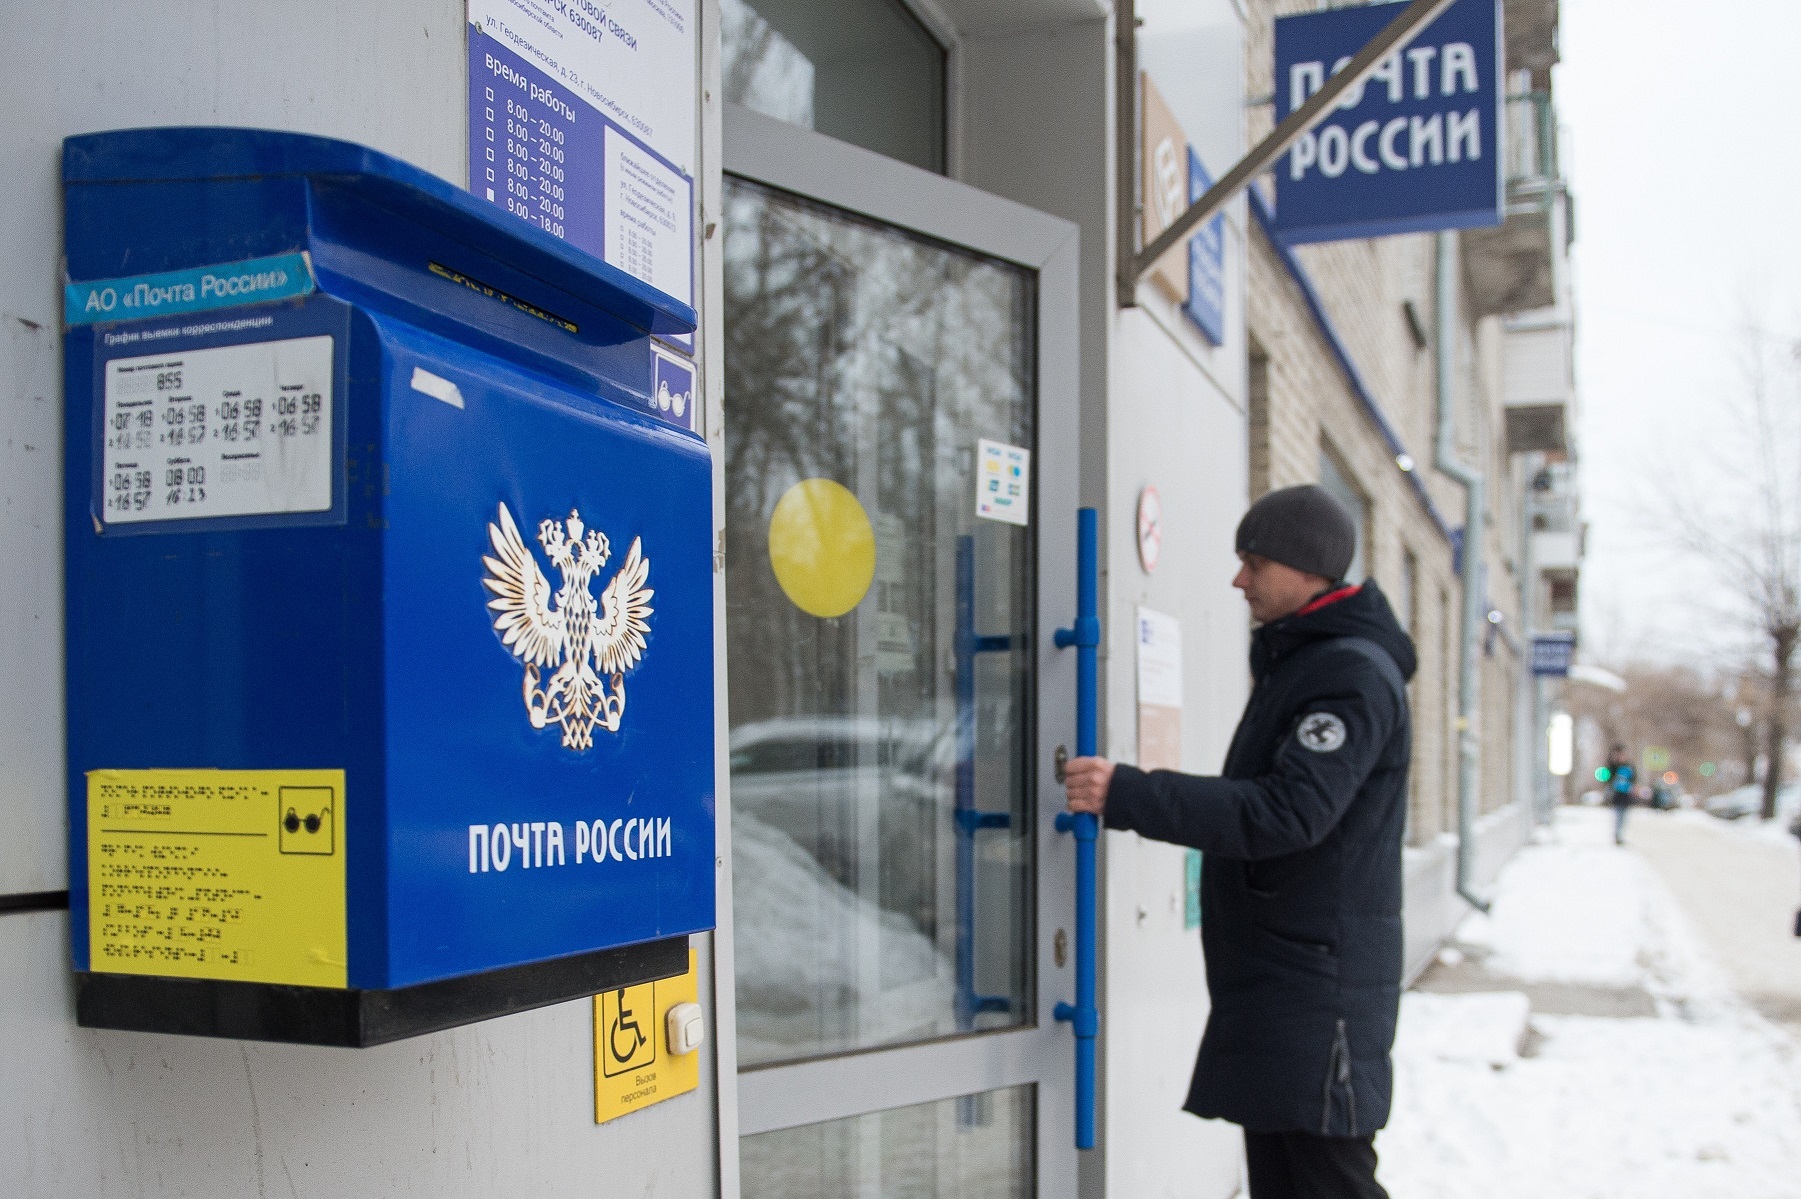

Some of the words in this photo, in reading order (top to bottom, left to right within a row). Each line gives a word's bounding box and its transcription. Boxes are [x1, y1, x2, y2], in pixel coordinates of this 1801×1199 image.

[569, 8, 603, 43] 630087
[608, 19, 637, 51] СВЯЗИ
[485, 14, 498, 30] ул.
[500, 21, 559, 73] Геодезическая,
[569, 70, 580, 87] 23,
[485, 53, 527, 91] время
[530, 83, 575, 123] работы
[507, 99, 528, 122] 8.00
[540, 120, 564, 145] 20.00
[507, 119, 528, 141] 8.00
[540, 139, 564, 163] 20.00
[507, 139, 528, 161] 8.00
[540, 158, 564, 182] 20.00
[1290, 107, 1482, 181] РОССИИ
[507, 158, 528, 181] 8.00
[540, 177, 564, 201] 20.00
[507, 178, 528, 200] 8.00
[540, 196, 564, 220] 20.00
[507, 198, 528, 220] 9.00
[540, 215, 564, 239] 18.00
[85, 288, 117, 312] АО
[122, 283, 196, 307] «Почта
[201, 270, 289, 299] России»
[104, 331, 140, 346] График
[142, 327, 180, 340] выемки
[181, 315, 274, 337] корреспонденции
[156, 370, 182, 390] 855
[468, 821, 566, 874] ПОЧТА
[575, 816, 672, 864] РОССИИ
[620, 1084, 657, 1104] персонала
[635, 1072, 657, 1086] Вызов
